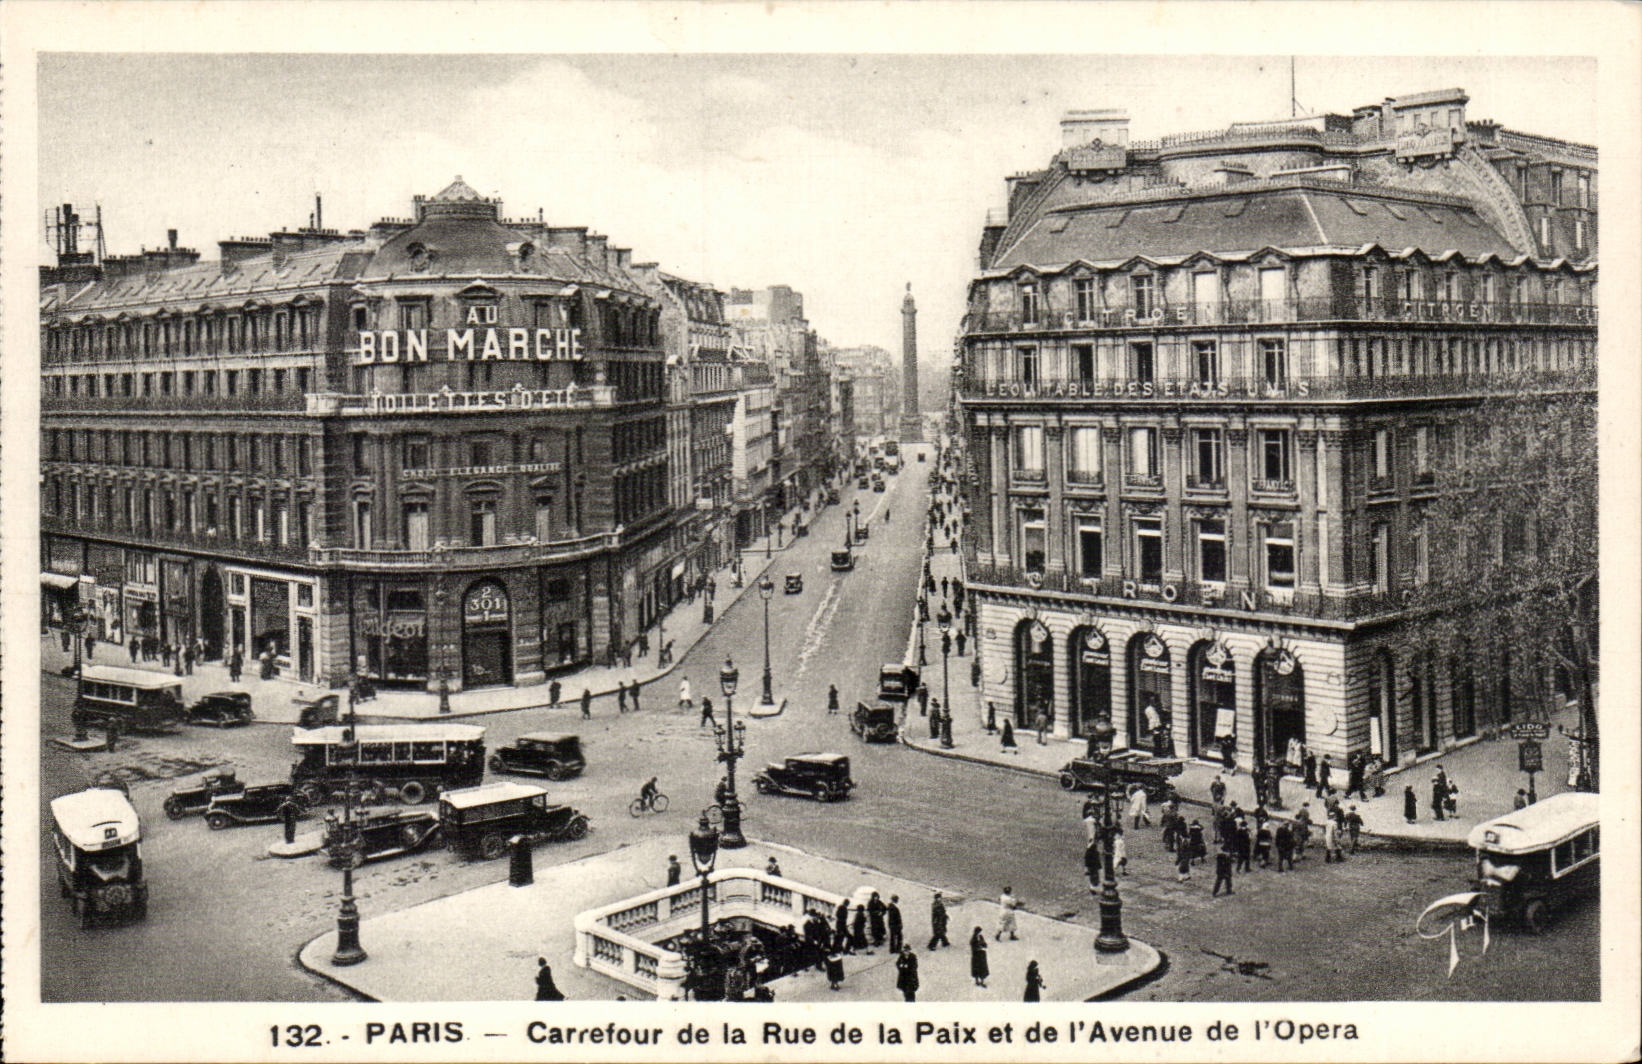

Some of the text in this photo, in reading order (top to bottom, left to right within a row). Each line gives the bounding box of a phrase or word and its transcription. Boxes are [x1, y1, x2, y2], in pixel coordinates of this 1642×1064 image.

[466, 305, 498, 324] AU
[359, 327, 583, 364] BON MARCHE
[1113, 381, 1153, 396] DES
[1164, 381, 1229, 396] ETATS
[372, 390, 506, 413] TOILETTES
[481, 586, 492, 599] 2
[470, 598, 501, 611] 301
